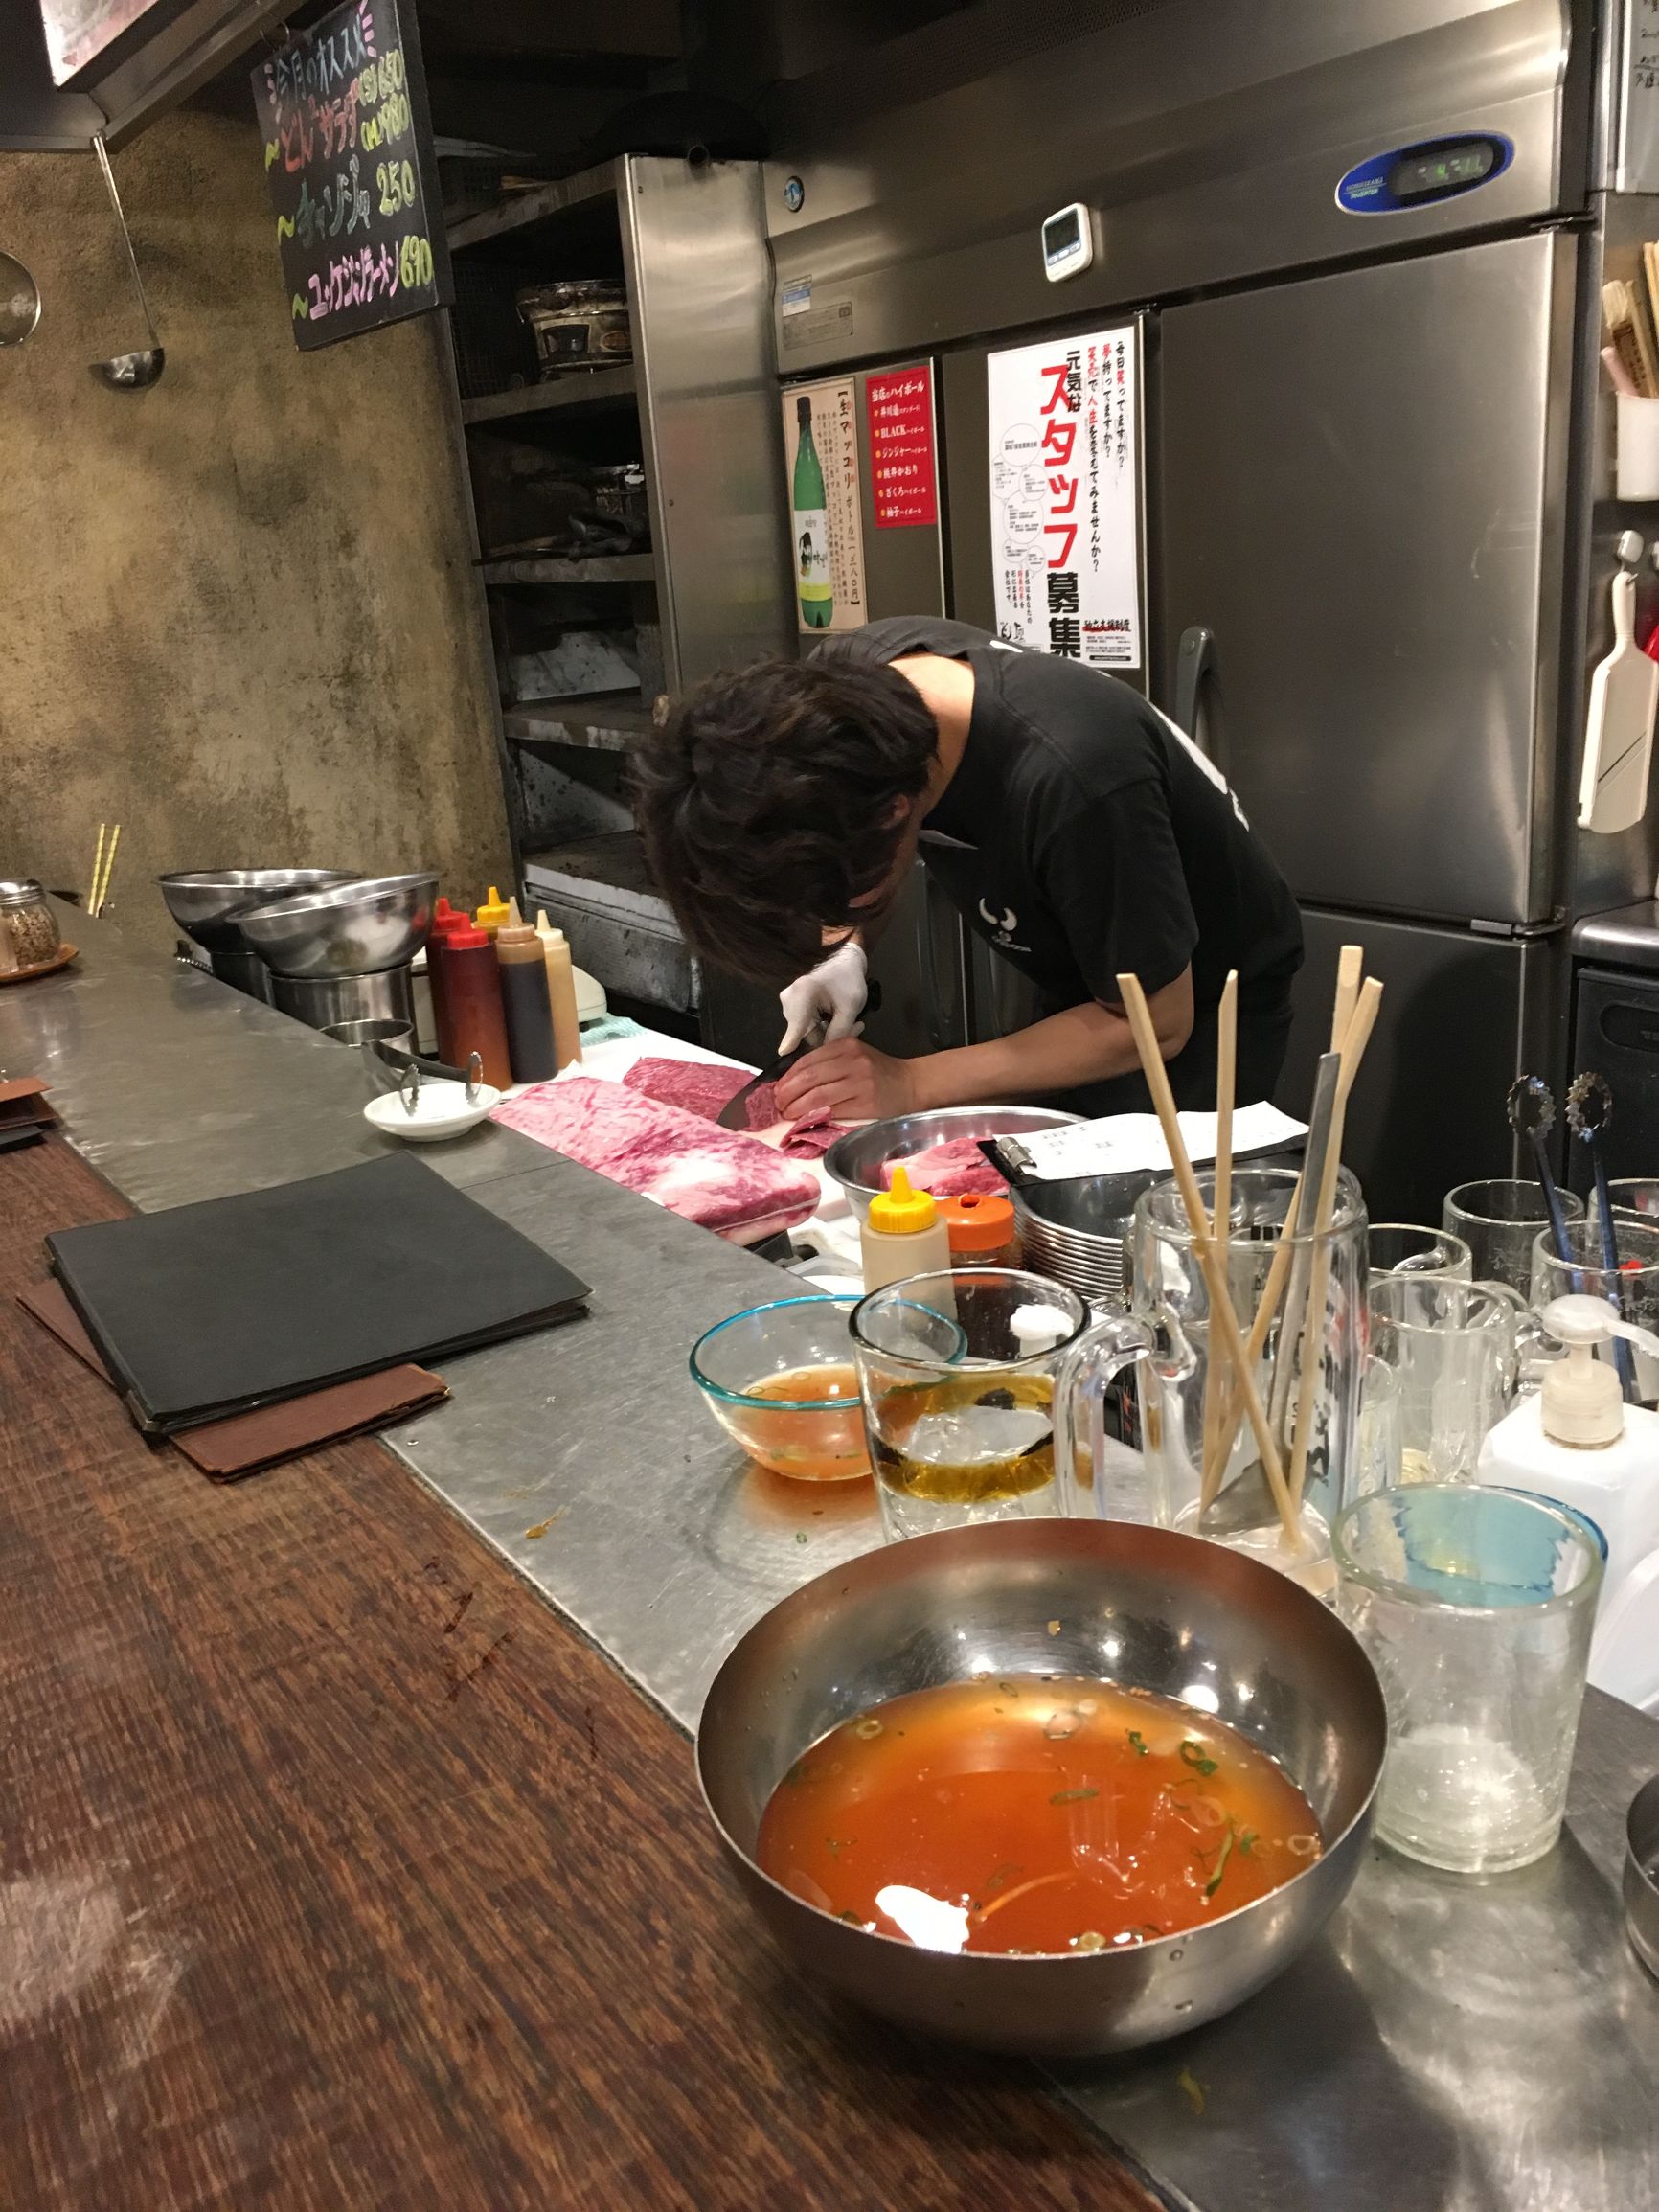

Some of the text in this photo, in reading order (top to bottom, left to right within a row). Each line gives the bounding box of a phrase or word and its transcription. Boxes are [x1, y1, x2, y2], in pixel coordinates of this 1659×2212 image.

[376, 159, 415, 217] 250
[400, 235, 432, 288] 690
[872, 380, 925, 402] 当店のハイボール
[1066, 350, 1081, 413] 元気な
